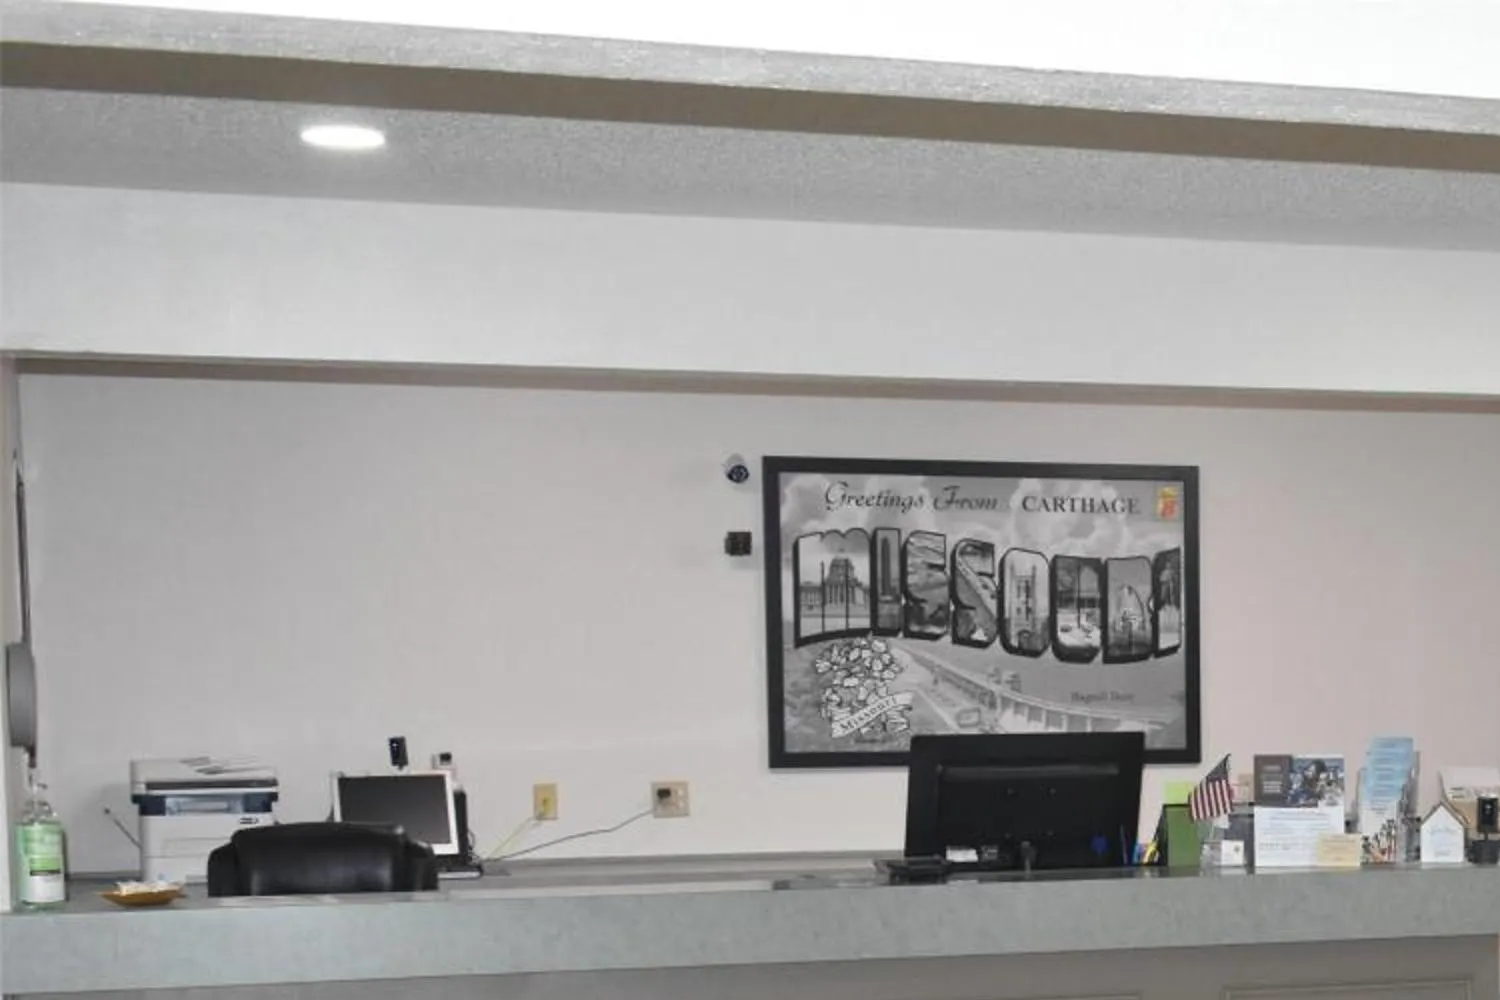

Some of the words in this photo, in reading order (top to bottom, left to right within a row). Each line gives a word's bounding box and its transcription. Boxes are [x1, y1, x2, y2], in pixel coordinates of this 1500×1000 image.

[824, 481, 925, 514] Greetings
[933, 485, 999, 512] From
[1022, 494, 1142, 514] CARTHAGE
[793, 527, 1182, 664] MISSOURI
